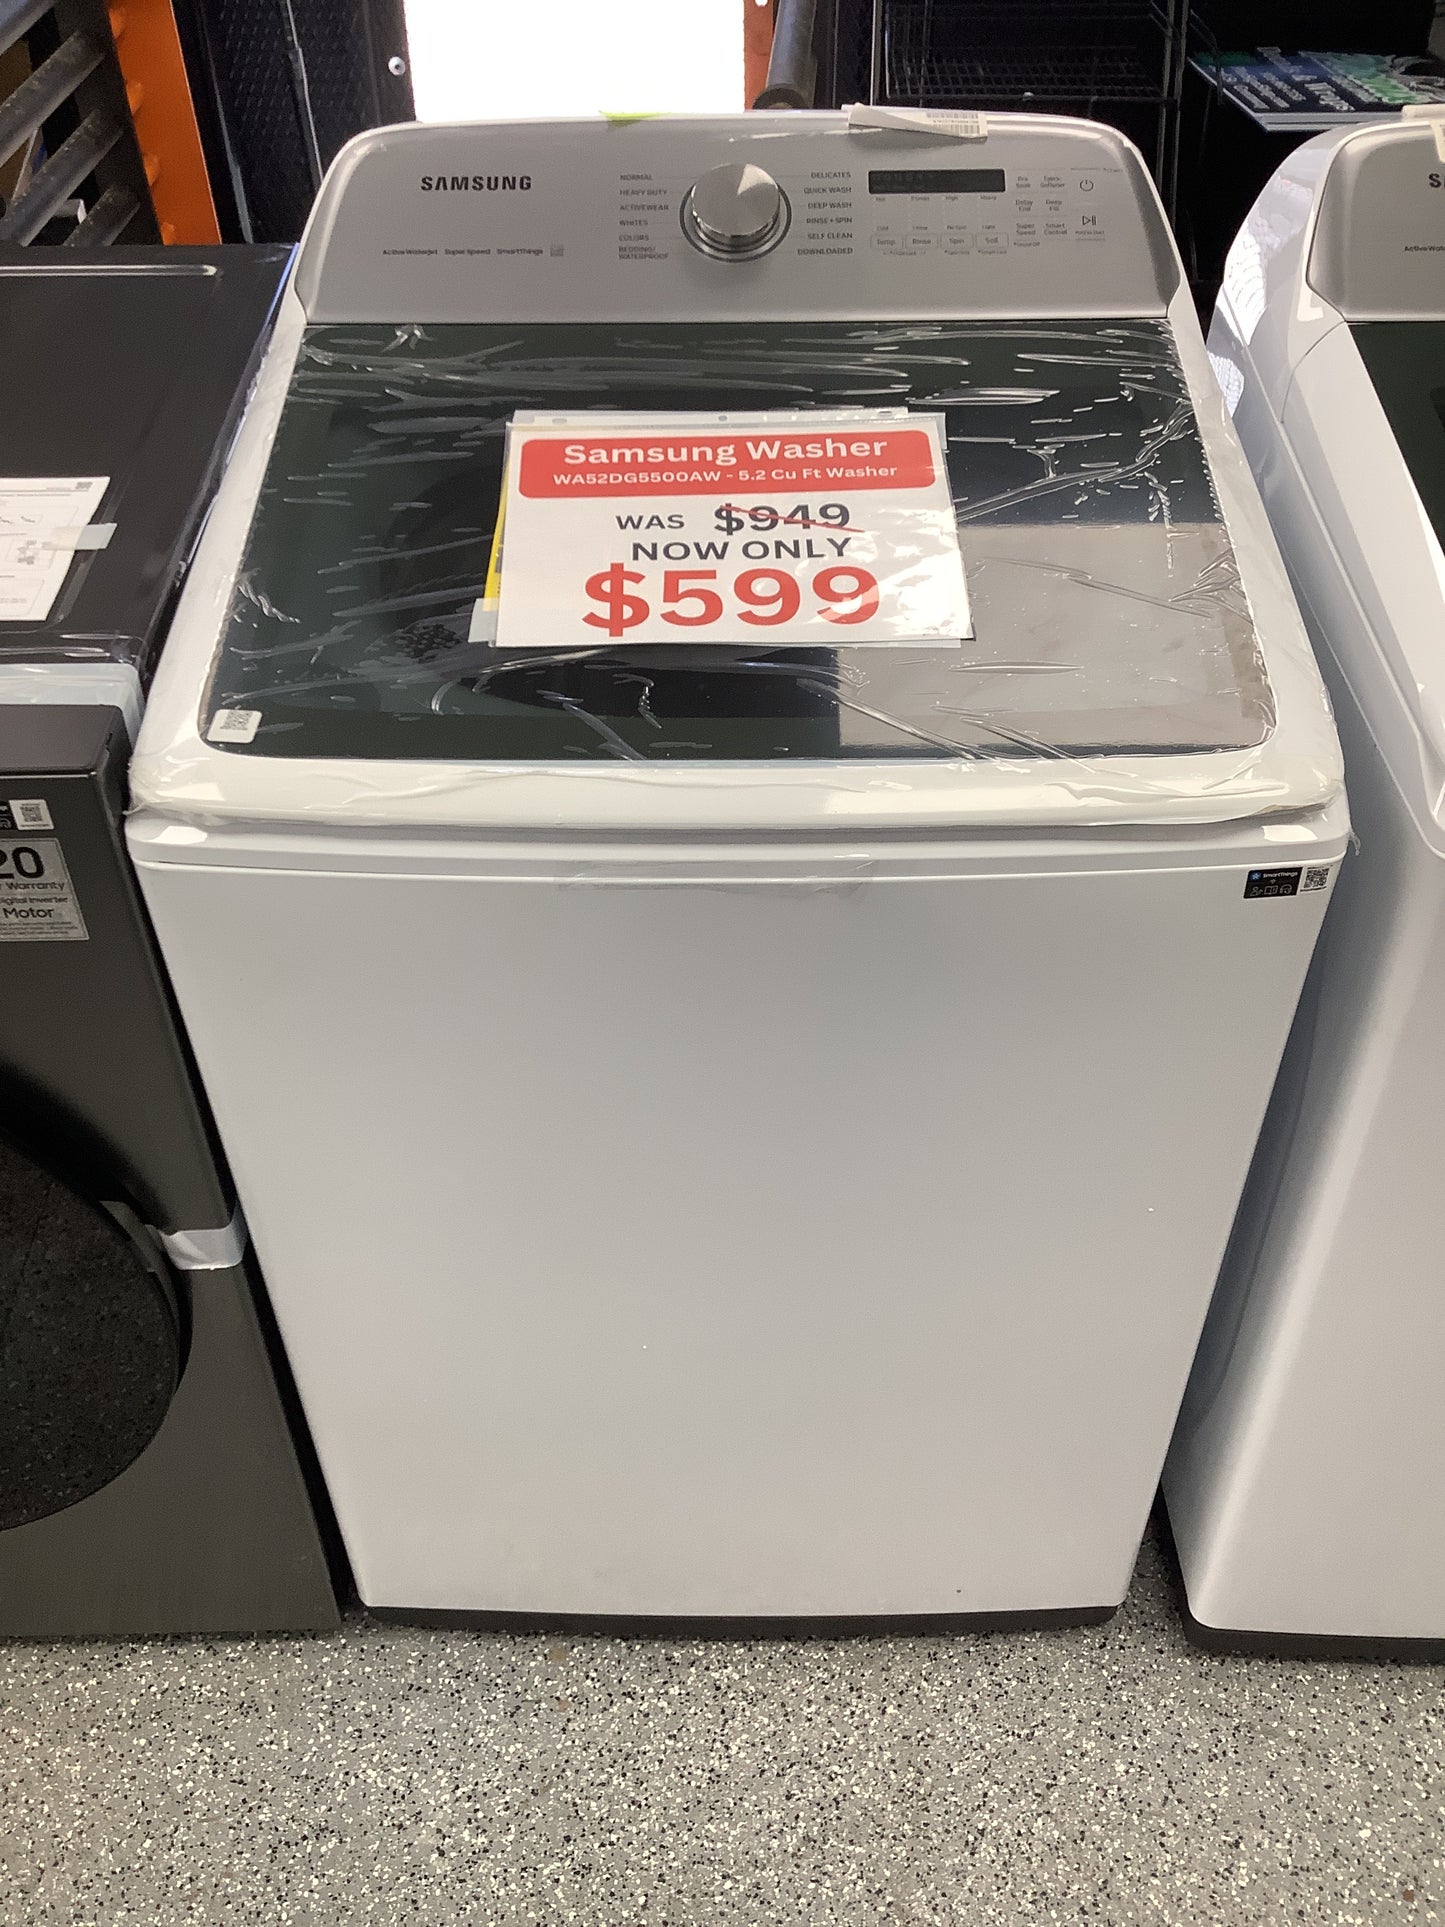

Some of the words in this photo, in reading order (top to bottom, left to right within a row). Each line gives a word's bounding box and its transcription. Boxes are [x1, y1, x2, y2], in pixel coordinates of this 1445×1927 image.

[810, 171, 852, 179] DELICATES
[420, 175, 532, 191] SAMSUNG
[1428, 173, 1445, 188] S
[619, 188, 645, 196] HEAVY
[646, 188, 667, 196] DUTY
[803, 187, 827, 195] QUICK
[828, 186, 852, 194] WASH
[829, 201, 852, 209] WASH
[835, 216, 853, 224] SPIN
[826, 232, 853, 240] CLEAN
[444, 248, 465, 256] Super
[467, 248, 491, 256] Speed
[497, 248, 543, 256] SmartThings
[797, 247, 853, 255] DOWNLOADED
[564, 441, 737, 466] Samsung
[746, 438, 888, 461] Washer
[553, 469, 722, 486] WA52DG5500AW
[738, 468, 766, 481] 5.2
[771, 468, 797, 481] Cu
[802, 467, 822, 480] Ft
[826, 465, 898, 480] Washer
[615, 513, 685, 530] WAS
[713, 503, 851, 536] $949
[631, 540, 730, 561] NOW
[741, 536, 853, 560] ONLY
[581, 562, 880, 637] $599
[1263, 871, 1298, 879] SmartThings
[6, 882, 65, 891] Warranty
[3, 908, 54, 919] Motor
